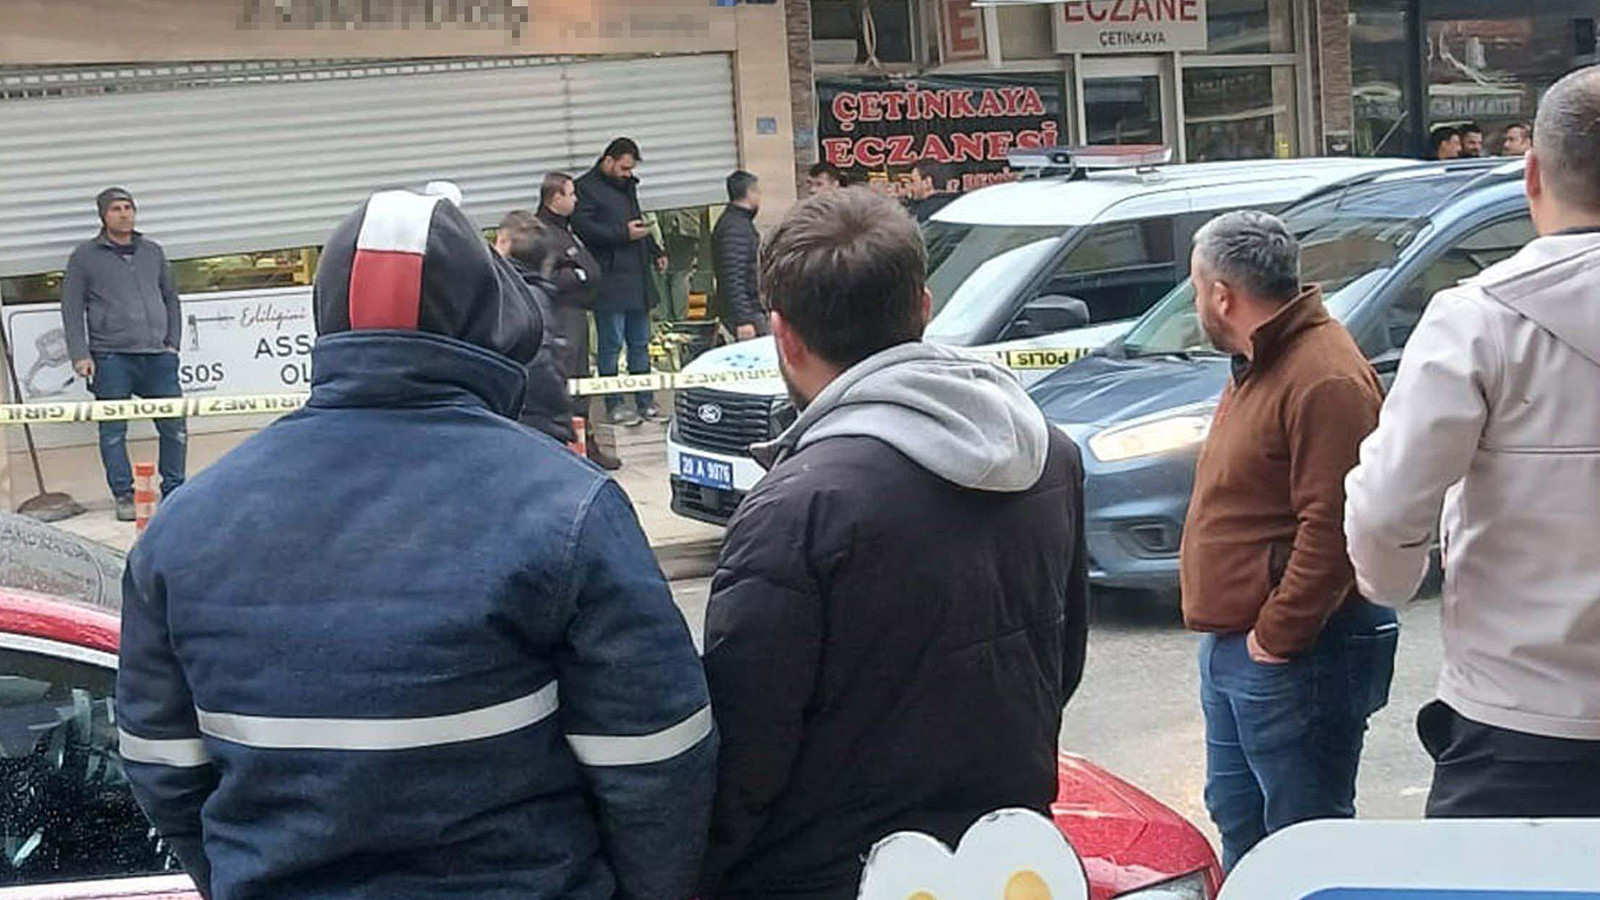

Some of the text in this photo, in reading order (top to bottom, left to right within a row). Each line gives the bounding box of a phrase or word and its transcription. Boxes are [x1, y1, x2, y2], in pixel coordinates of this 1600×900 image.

[1064, 0, 1198, 23] ECZANE
[832, 81, 1046, 131] ÇETİNKAYA
[822, 121, 1058, 168] ECZANESİ
[254, 334, 313, 359] ASS
[180, 362, 225, 384] SOS
[280, 363, 310, 385] OL
